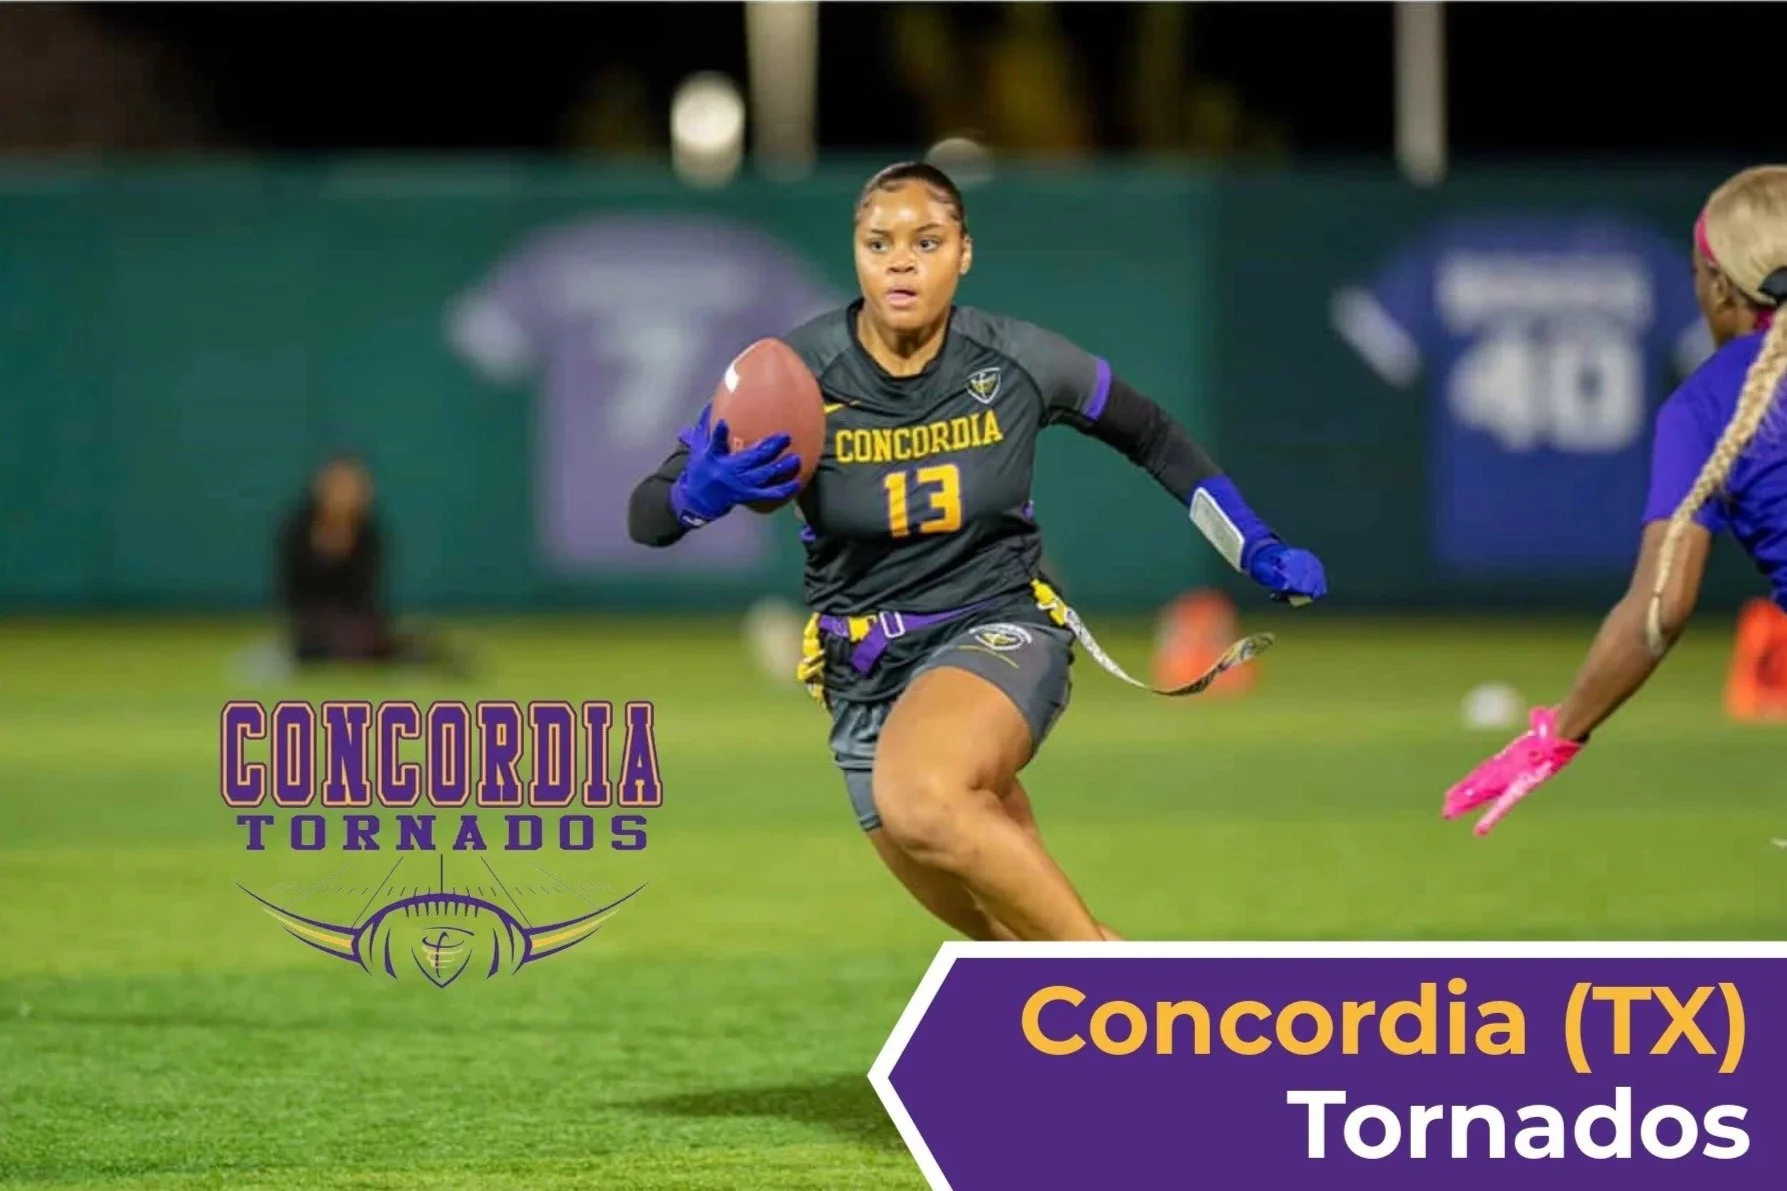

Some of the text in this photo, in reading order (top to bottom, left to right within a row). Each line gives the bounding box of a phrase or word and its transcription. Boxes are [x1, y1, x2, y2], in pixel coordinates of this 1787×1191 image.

[1450, 328, 1645, 452] 40
[834, 409, 1003, 464] CONCORDIA
[883, 463, 963, 538] 13
